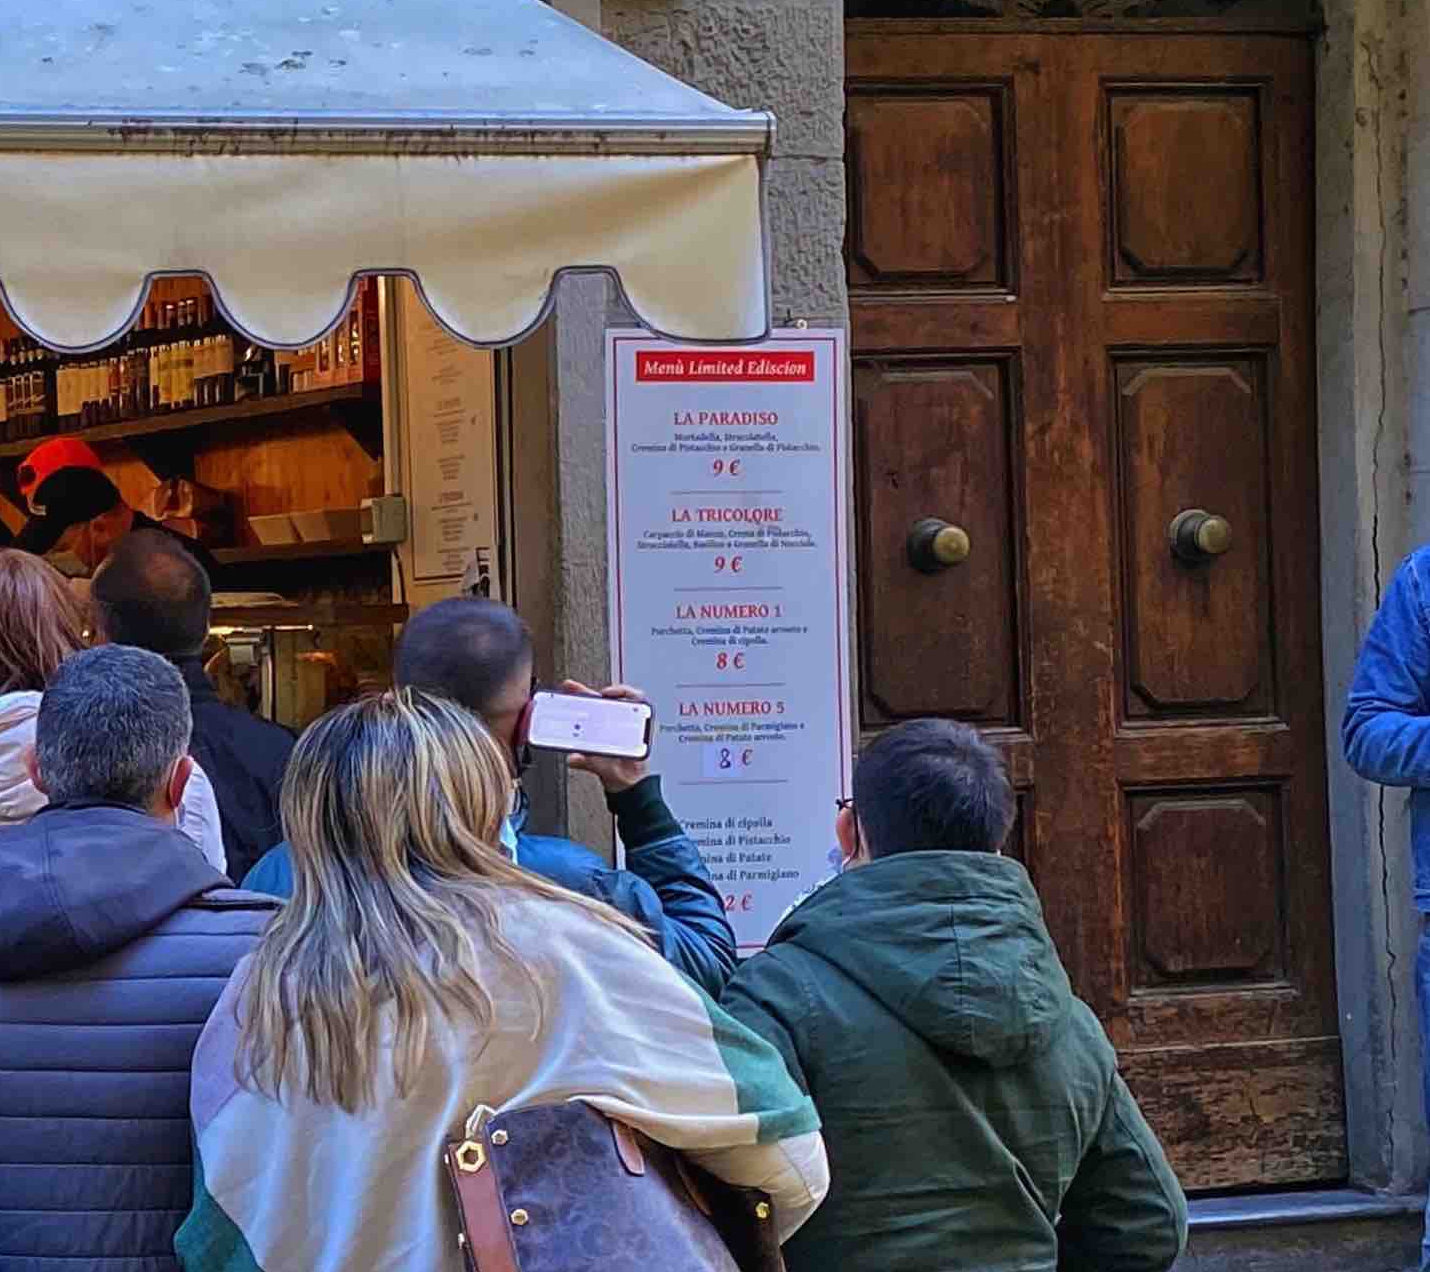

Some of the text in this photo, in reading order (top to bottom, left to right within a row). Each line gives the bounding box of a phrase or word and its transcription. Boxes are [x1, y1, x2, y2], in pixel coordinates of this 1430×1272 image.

[643, 357, 807, 376] Menù Limited Ediscion
[673, 412, 779, 426] LA PARADISO
[713, 459, 741, 477] 9 €
[672, 509, 691, 522] LA
[714, 555, 743, 574] 9 €
[675, 605, 782, 619] LA NUMERO 1
[716, 652, 745, 670] 8 €
[679, 702, 785, 716] LA NUMERO 5
[719, 747, 754, 770] 8 €
[742, 894, 753, 911] €
